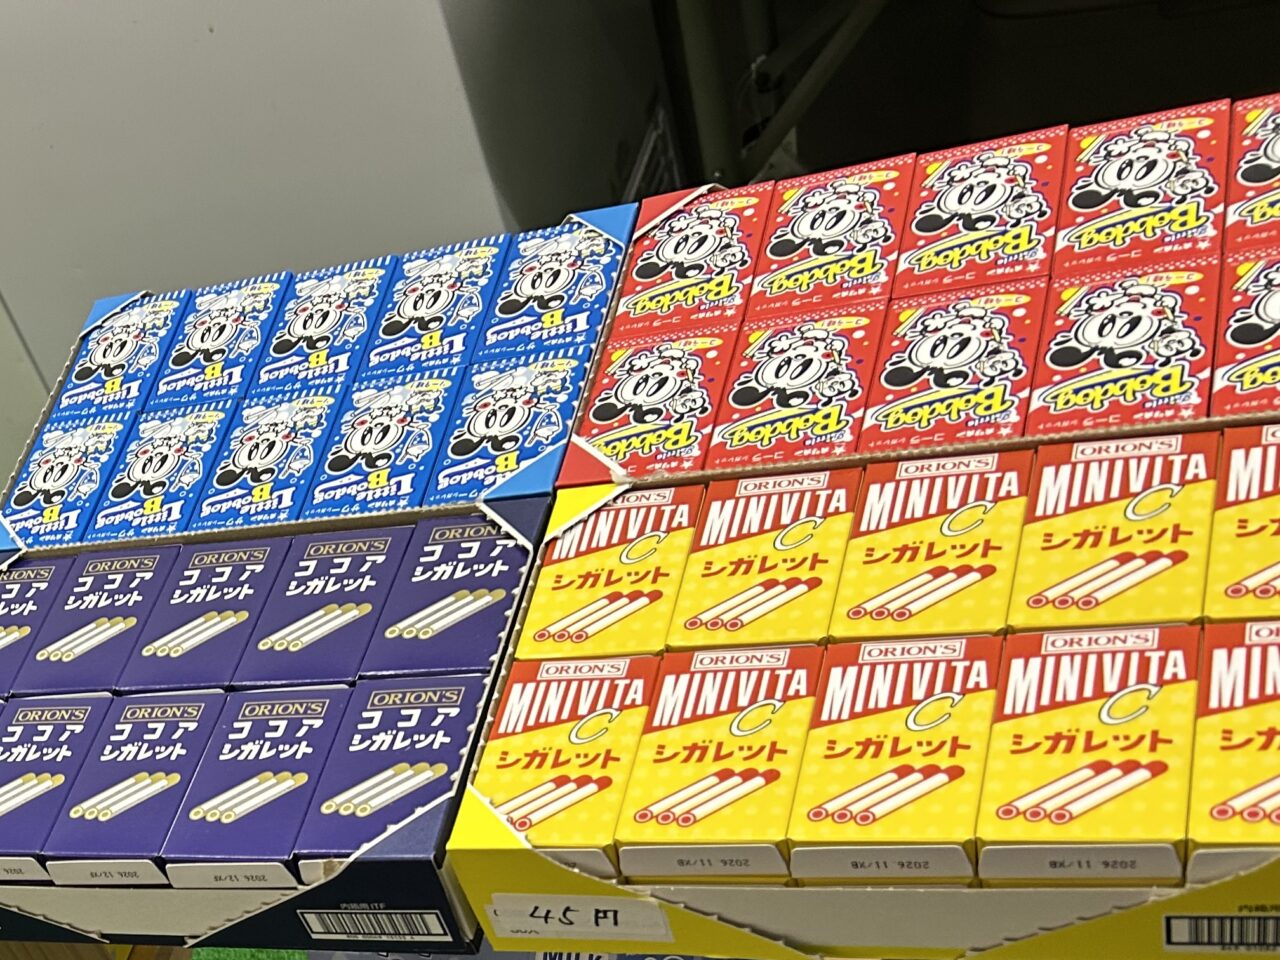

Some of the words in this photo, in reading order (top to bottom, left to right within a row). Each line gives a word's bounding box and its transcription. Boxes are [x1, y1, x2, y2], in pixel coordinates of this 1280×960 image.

[1074, 201, 1208, 250] Bobdog
[914, 224, 1041, 271] Bobdog
[627, 274, 735, 315] Bobdog
[485, 308, 565, 345] Bobdog
[531, 311, 591, 340] Little
[369, 329, 443, 367] Bobdog
[158, 362, 224, 395] Bobdog
[194, 365, 245, 391] Little
[259, 349, 329, 384] Bobdog
[297, 353, 351, 379] Little
[1044, 364, 1194, 411] Bobdog
[882, 384, 1014, 430] Bobdog
[722, 405, 849, 449] Bobdog
[1079, 440, 1175, 455] ORION'S
[437, 451, 520, 490] Bobdog
[904, 459, 990, 473] ORION'S
[314, 468, 391, 504] Bobdog
[356, 473, 415, 500] Little
[743, 476, 822, 492] ORION'S
[1035, 454, 1207, 516] MINIVITA
[201, 482, 272, 517] Bobdog
[240, 486, 296, 515] Little
[861, 471, 1018, 532] MINIVITA
[1124, 484, 1184, 520] C
[33, 509, 82, 536] Little
[701, 488, 846, 546] MINIVITA
[552, 504, 689, 560] MINIVITA
[773, 517, 824, 550] C
[1041, 523, 1192, 550] シガレット
[193, 549, 264, 563] ORION'S
[309, 540, 386, 554] ORION'S
[419, 540, 517, 562] ココア
[178, 565, 264, 586] ココア
[294, 556, 387, 576] ココア
[411, 560, 508, 582] シガレット
[702, 552, 828, 577] シガレット
[74, 572, 154, 592] ココア
[286, 574, 377, 595] シガレット
[551, 567, 669, 591] シガレット
[65, 591, 142, 609] シガレット
[170, 584, 254, 604] シガレット
[866, 643, 957, 658] ORION'S
[1051, 632, 1154, 649] ORION'S
[545, 662, 622, 675] ORION'S
[699, 652, 782, 666] ORION'S
[821, 661, 988, 720] MINIVITA
[1003, 650, 1187, 714] MINIVITA
[244, 702, 323, 716] ORION'S
[498, 679, 644, 733] MINIVITA
[652, 669, 807, 727] MINIVITA
[1098, 684, 1163, 724] C
[18, 709, 85, 721] ORION'S
[126, 706, 198, 719] ORION'S
[358, 708, 459, 730] ココア
[730, 700, 785, 736] C
[2, 724, 83, 742] ココア
[110, 722, 198, 741] ココア
[228, 719, 324, 740] ココア
[349, 730, 450, 752] シガレット
[1010, 729, 1172, 754] シガレット
[100, 742, 186, 762] シガレット
[220, 739, 313, 760] シガレット
[497, 745, 620, 769] シガレット
[653, 741, 787, 764] シガレット
[824, 736, 971, 760] シガレット
